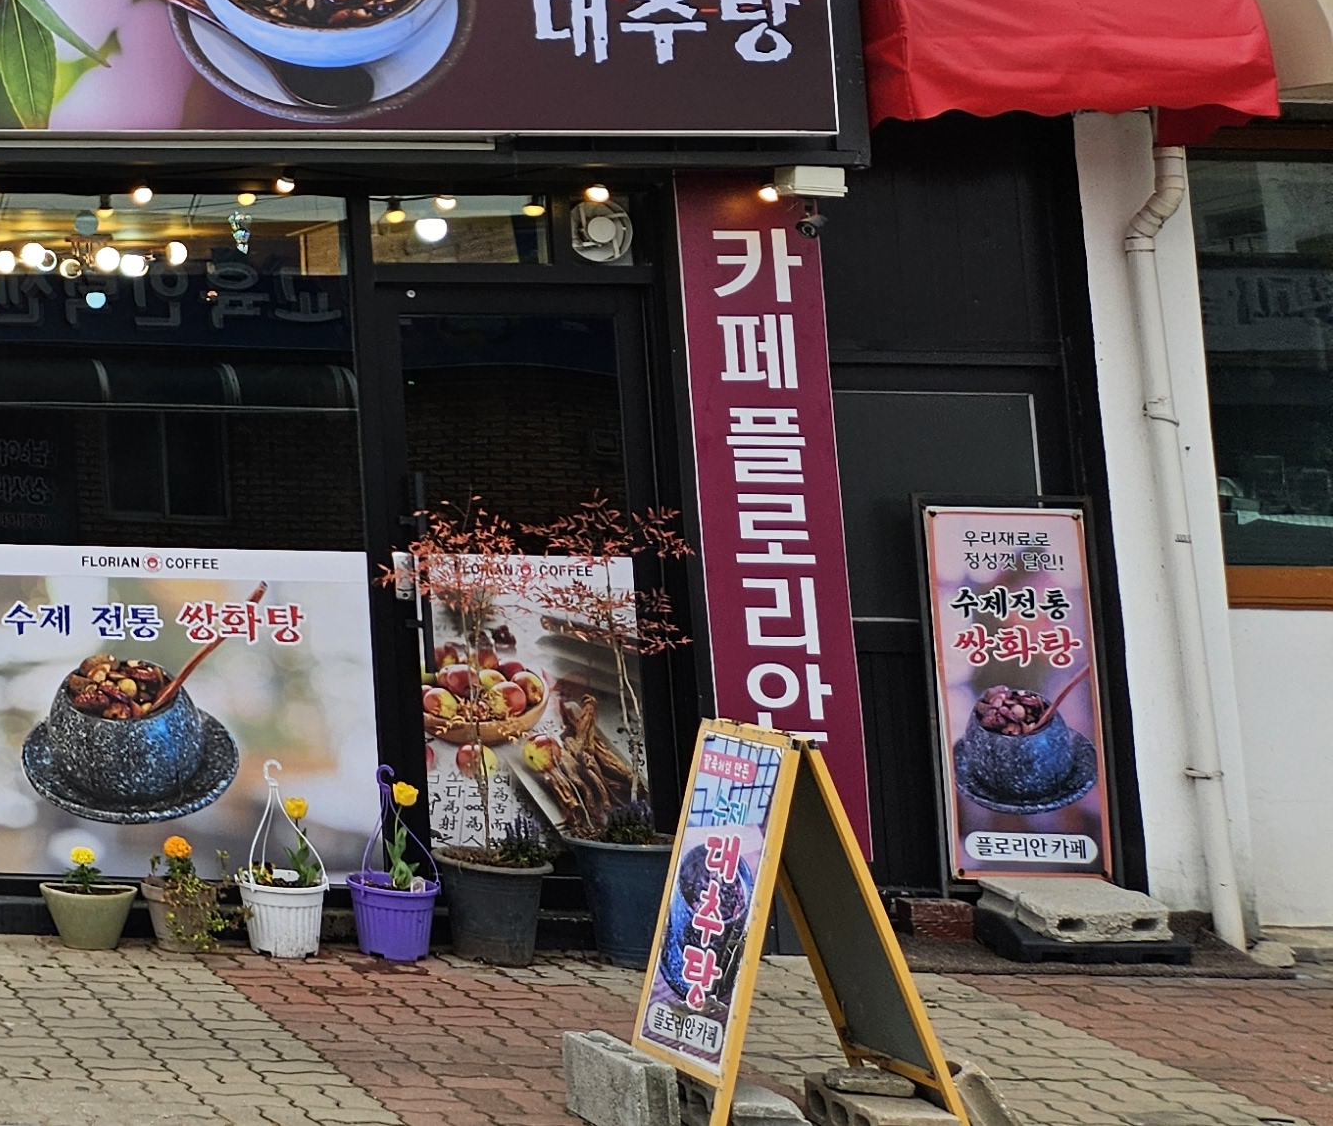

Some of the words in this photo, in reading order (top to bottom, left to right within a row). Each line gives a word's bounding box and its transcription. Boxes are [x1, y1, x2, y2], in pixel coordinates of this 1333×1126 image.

[713, 228, 802, 389] 카페
[962, 531, 1051, 547] 우리재료로
[81, 555, 140, 569] FLORIAN
[165, 557, 220, 570] COFFEE
[539, 564, 594, 577] COFFEE
[964, 552, 1016, 572] 정성껏
[1022, 552, 1065, 572] 달인!
[950, 587, 1071, 621] 수제전통
[4, 602, 71, 636] 수제
[91, 603, 161, 639] 전통
[179, 602, 304, 643] 쌍화탕
[954, 625, 1082, 667] 쌍화탕
[734, 762, 750, 780] 만든
[974, 833, 1048, 858] 플로리안
[1051, 837, 1087, 860] 카페
[682, 833, 742, 1012] 대추탕
[653, 1006, 696, 1040] 플로리안
